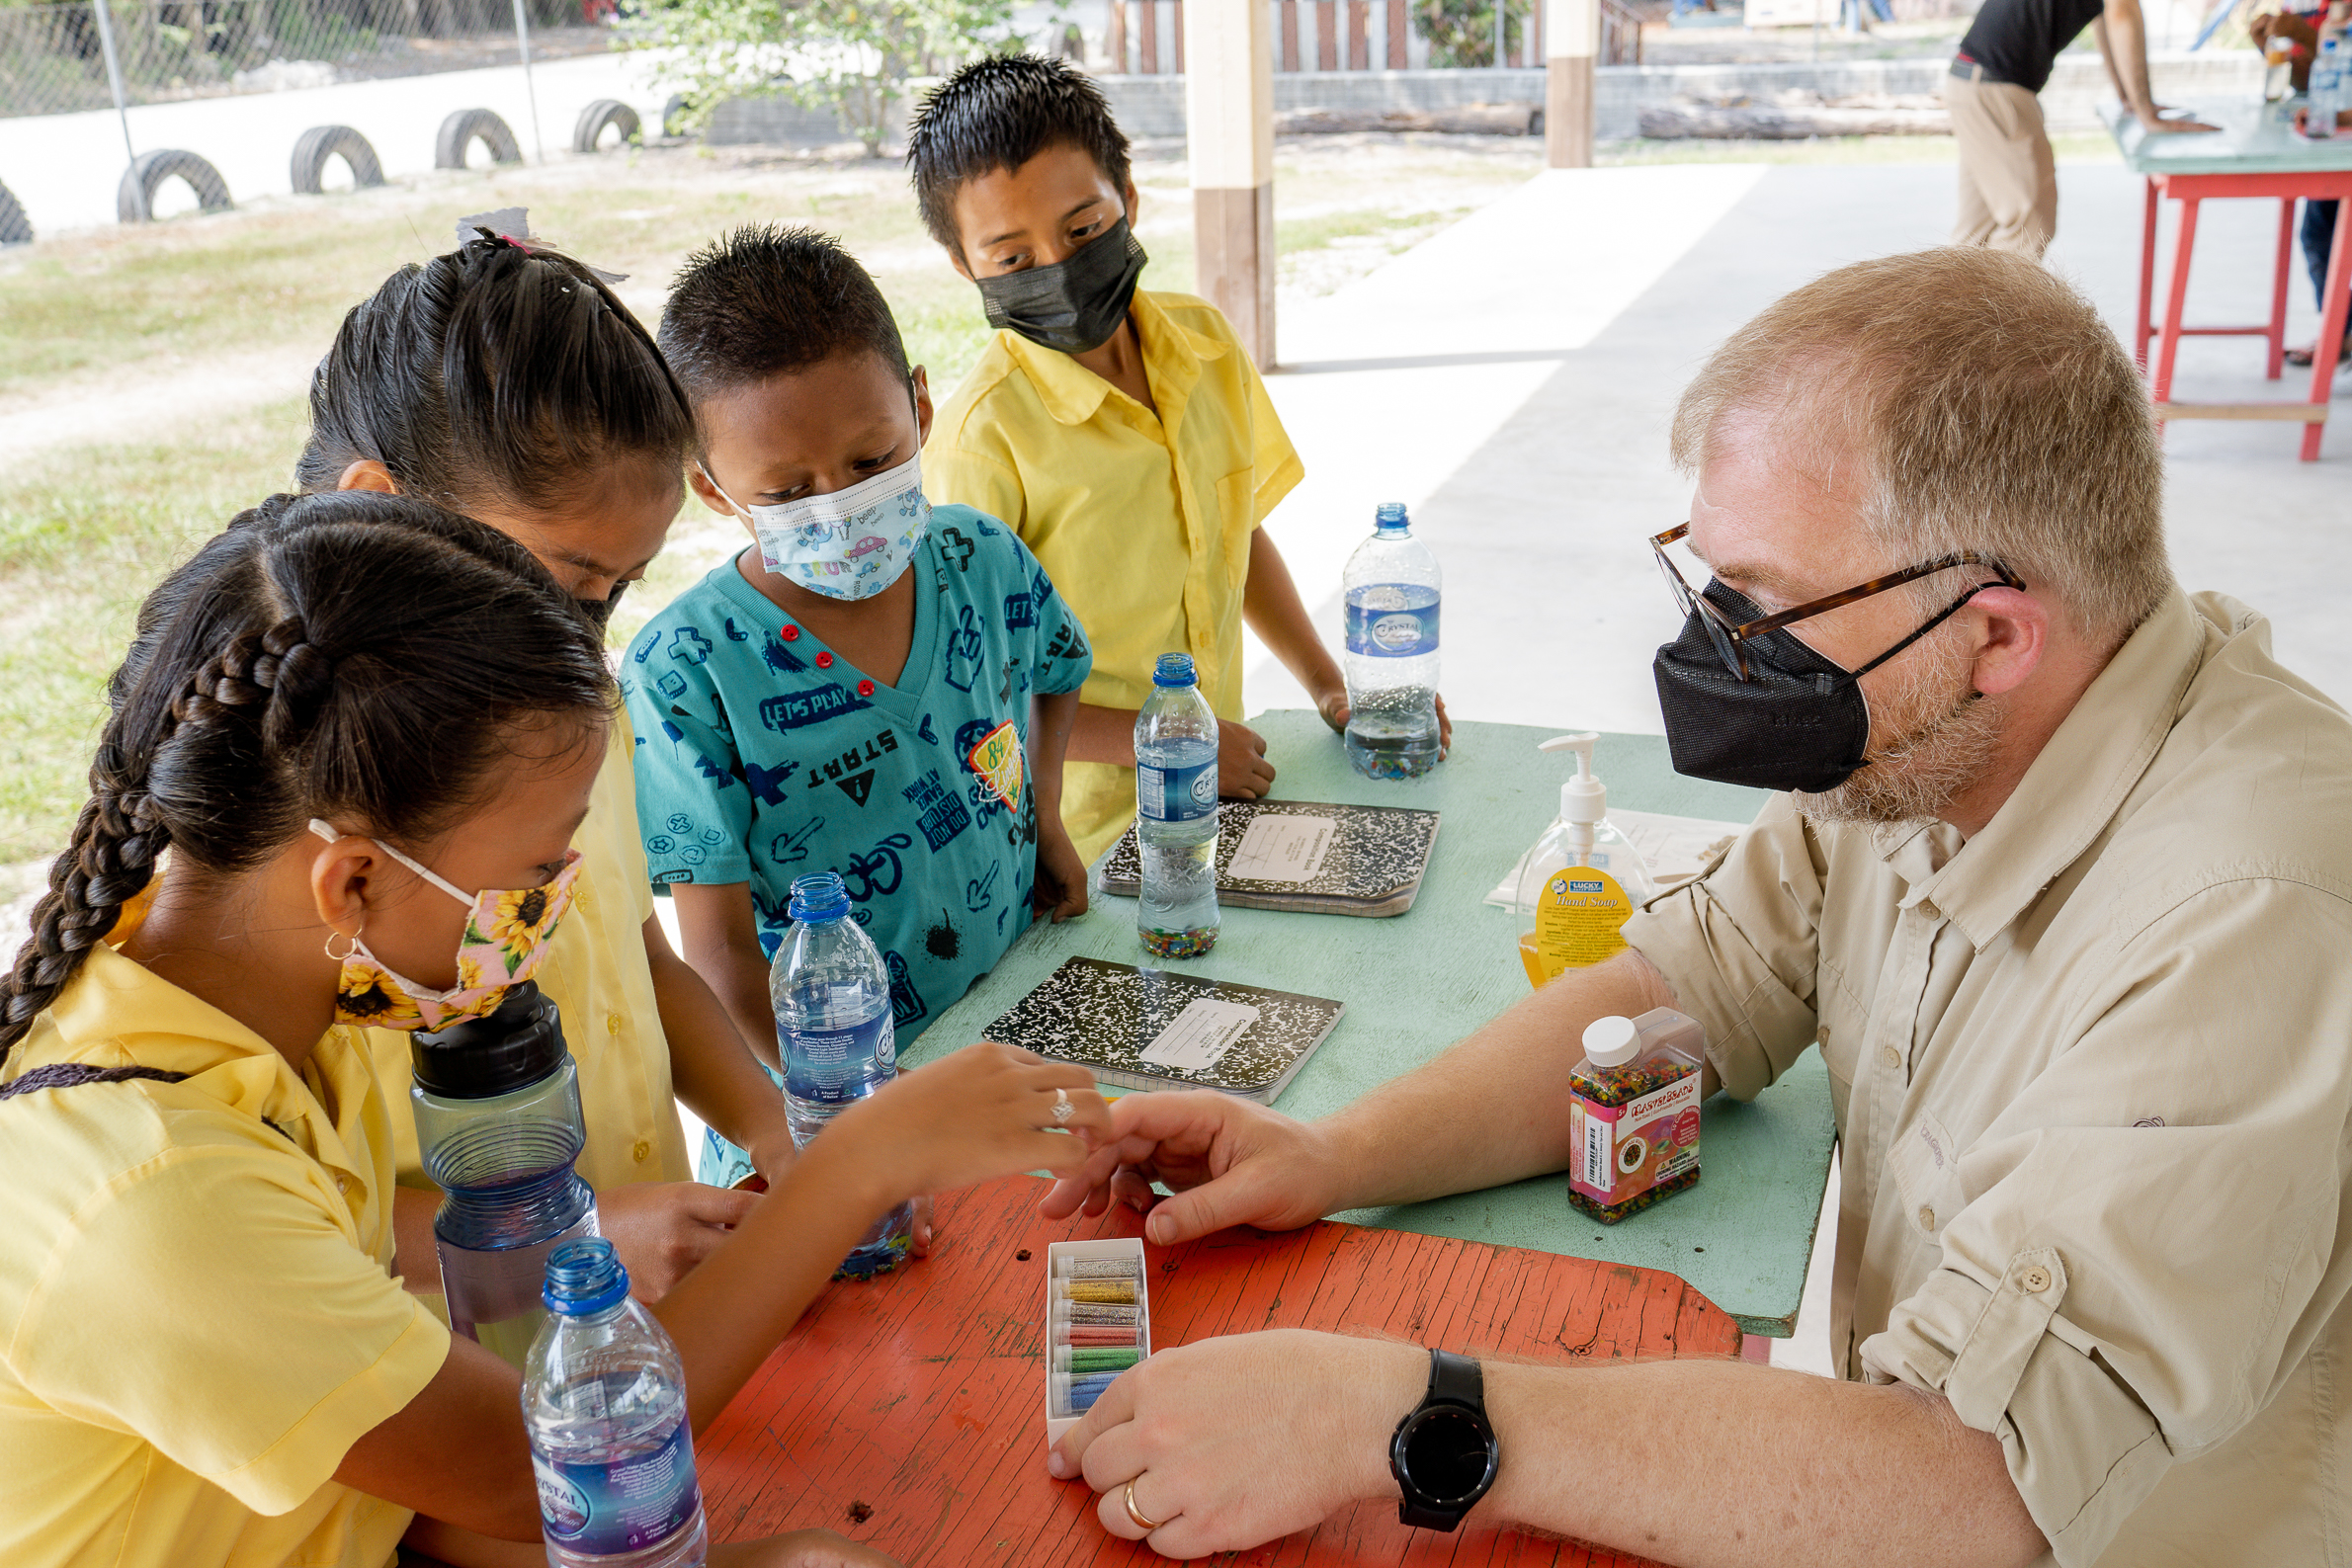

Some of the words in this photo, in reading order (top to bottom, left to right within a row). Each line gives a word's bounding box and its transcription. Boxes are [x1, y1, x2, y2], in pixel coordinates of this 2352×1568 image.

[857, 506, 877, 525] beep
[810, 688, 848, 713] PLAY
[807, 728, 899, 789] START
[988, 735, 1004, 770] 84
[900, 777, 929, 803] WORK
[922, 793, 960, 833] DISTURB
[950, 810, 966, 830] DO
[931, 822, 952, 847] NOT
[1555, 895, 1587, 907] Hand
[1589, 896, 1618, 908] Soap
[1669, 1150, 1691, 1165] WARNING
